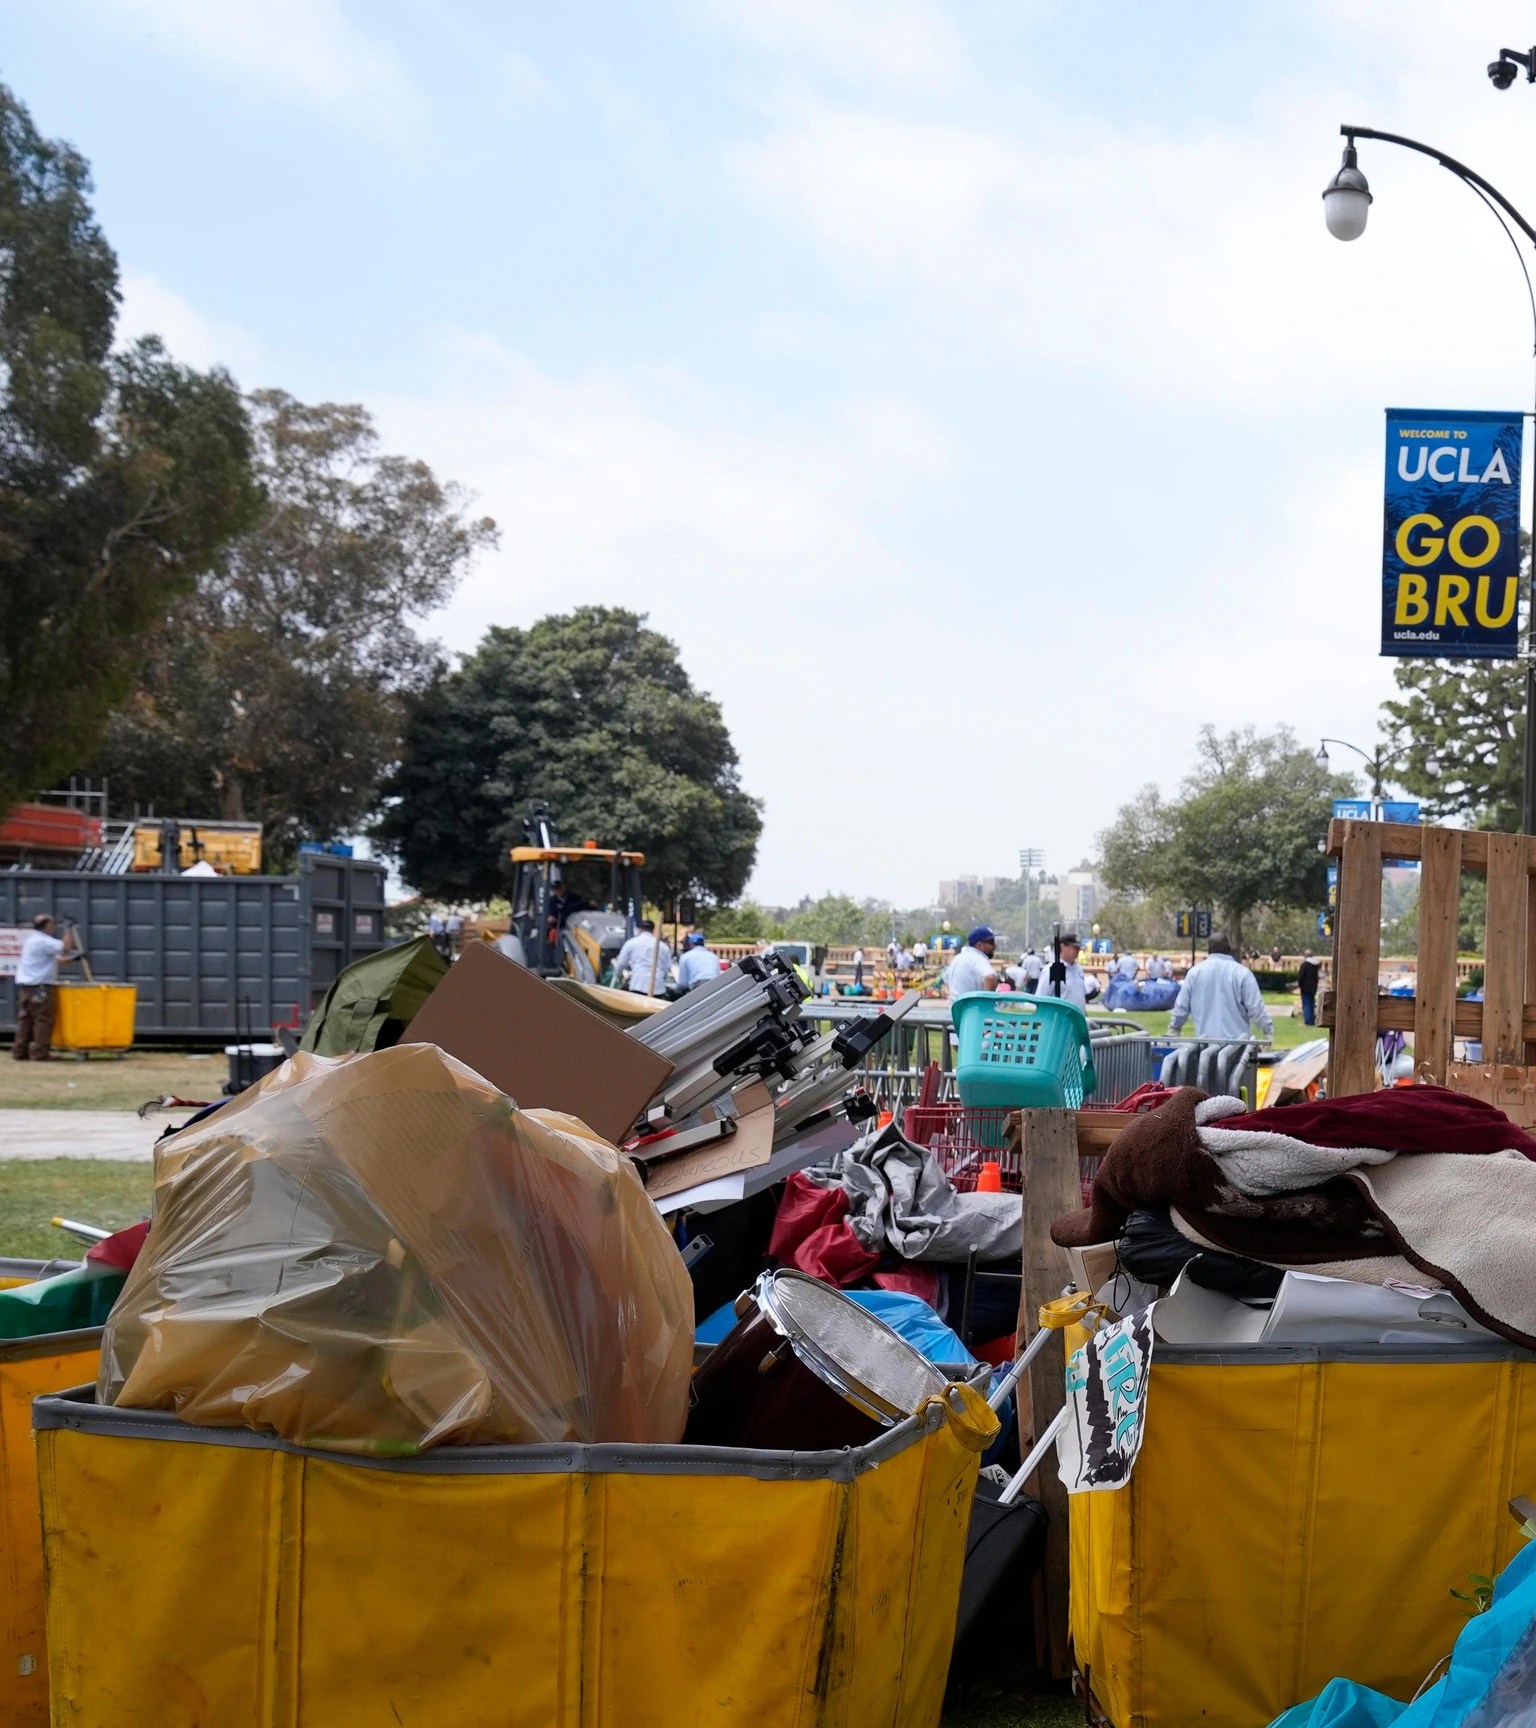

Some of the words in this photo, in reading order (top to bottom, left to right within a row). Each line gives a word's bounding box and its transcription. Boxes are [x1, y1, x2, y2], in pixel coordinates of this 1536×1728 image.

[1399, 429, 1450, 439] WELCOME
[1453, 431, 1467, 440] TO
[1398, 446, 1512, 485] UCLA
[1395, 513, 1501, 568] GO
[1394, 630, 1440, 641] ucla.edu
[1336, 808, 1370, 820] UCLA
